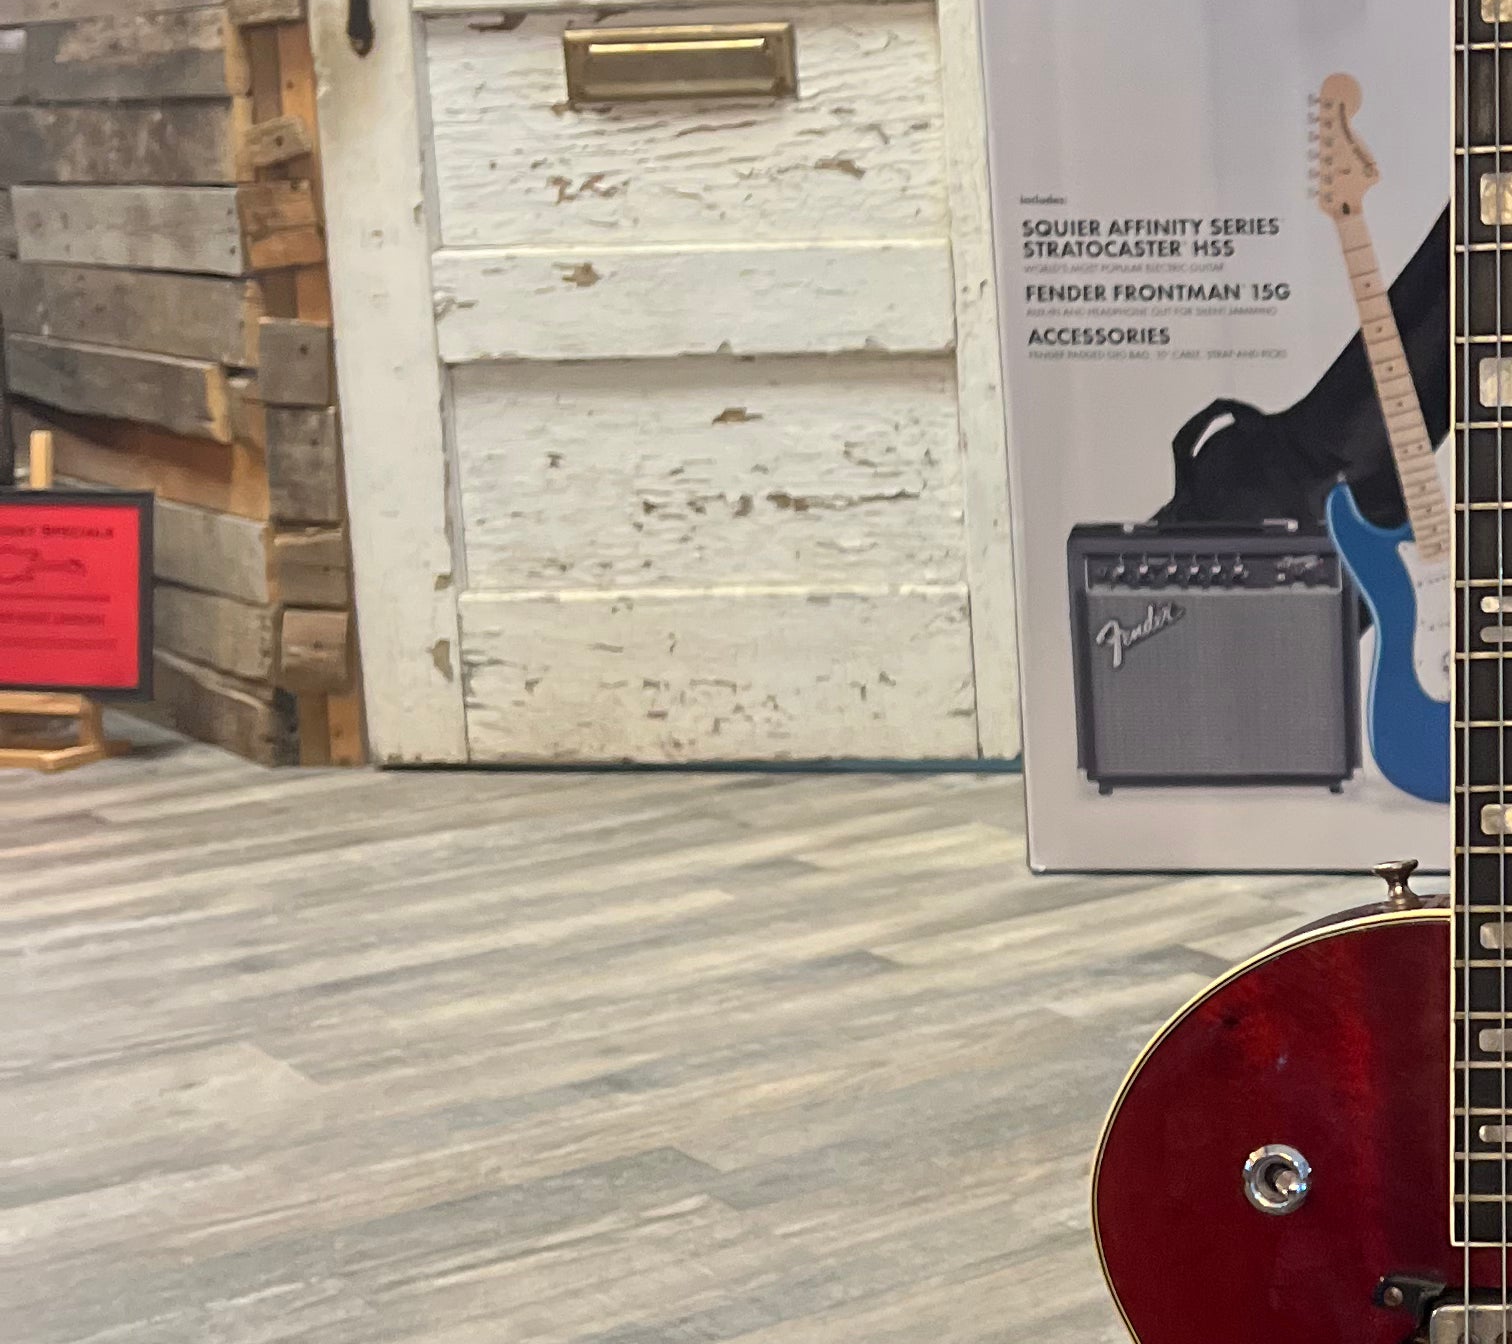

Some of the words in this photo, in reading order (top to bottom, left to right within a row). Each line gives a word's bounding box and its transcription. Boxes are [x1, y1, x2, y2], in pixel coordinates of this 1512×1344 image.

[1022, 219, 1100, 237] SQUIER
[1108, 218, 1204, 236] AFFINITY
[1210, 217, 1280, 235] SERIES
[1023, 239, 1181, 258] STRATOCASTER
[1193, 239, 1235, 257] HSS
[1025, 284, 1106, 303] FENDER
[1113, 283, 1241, 302] FRONTMAN
[1252, 282, 1291, 301] 15G
[1028, 327, 1171, 346] ACCESSORIES
[1096, 604, 1184, 668] Fender
